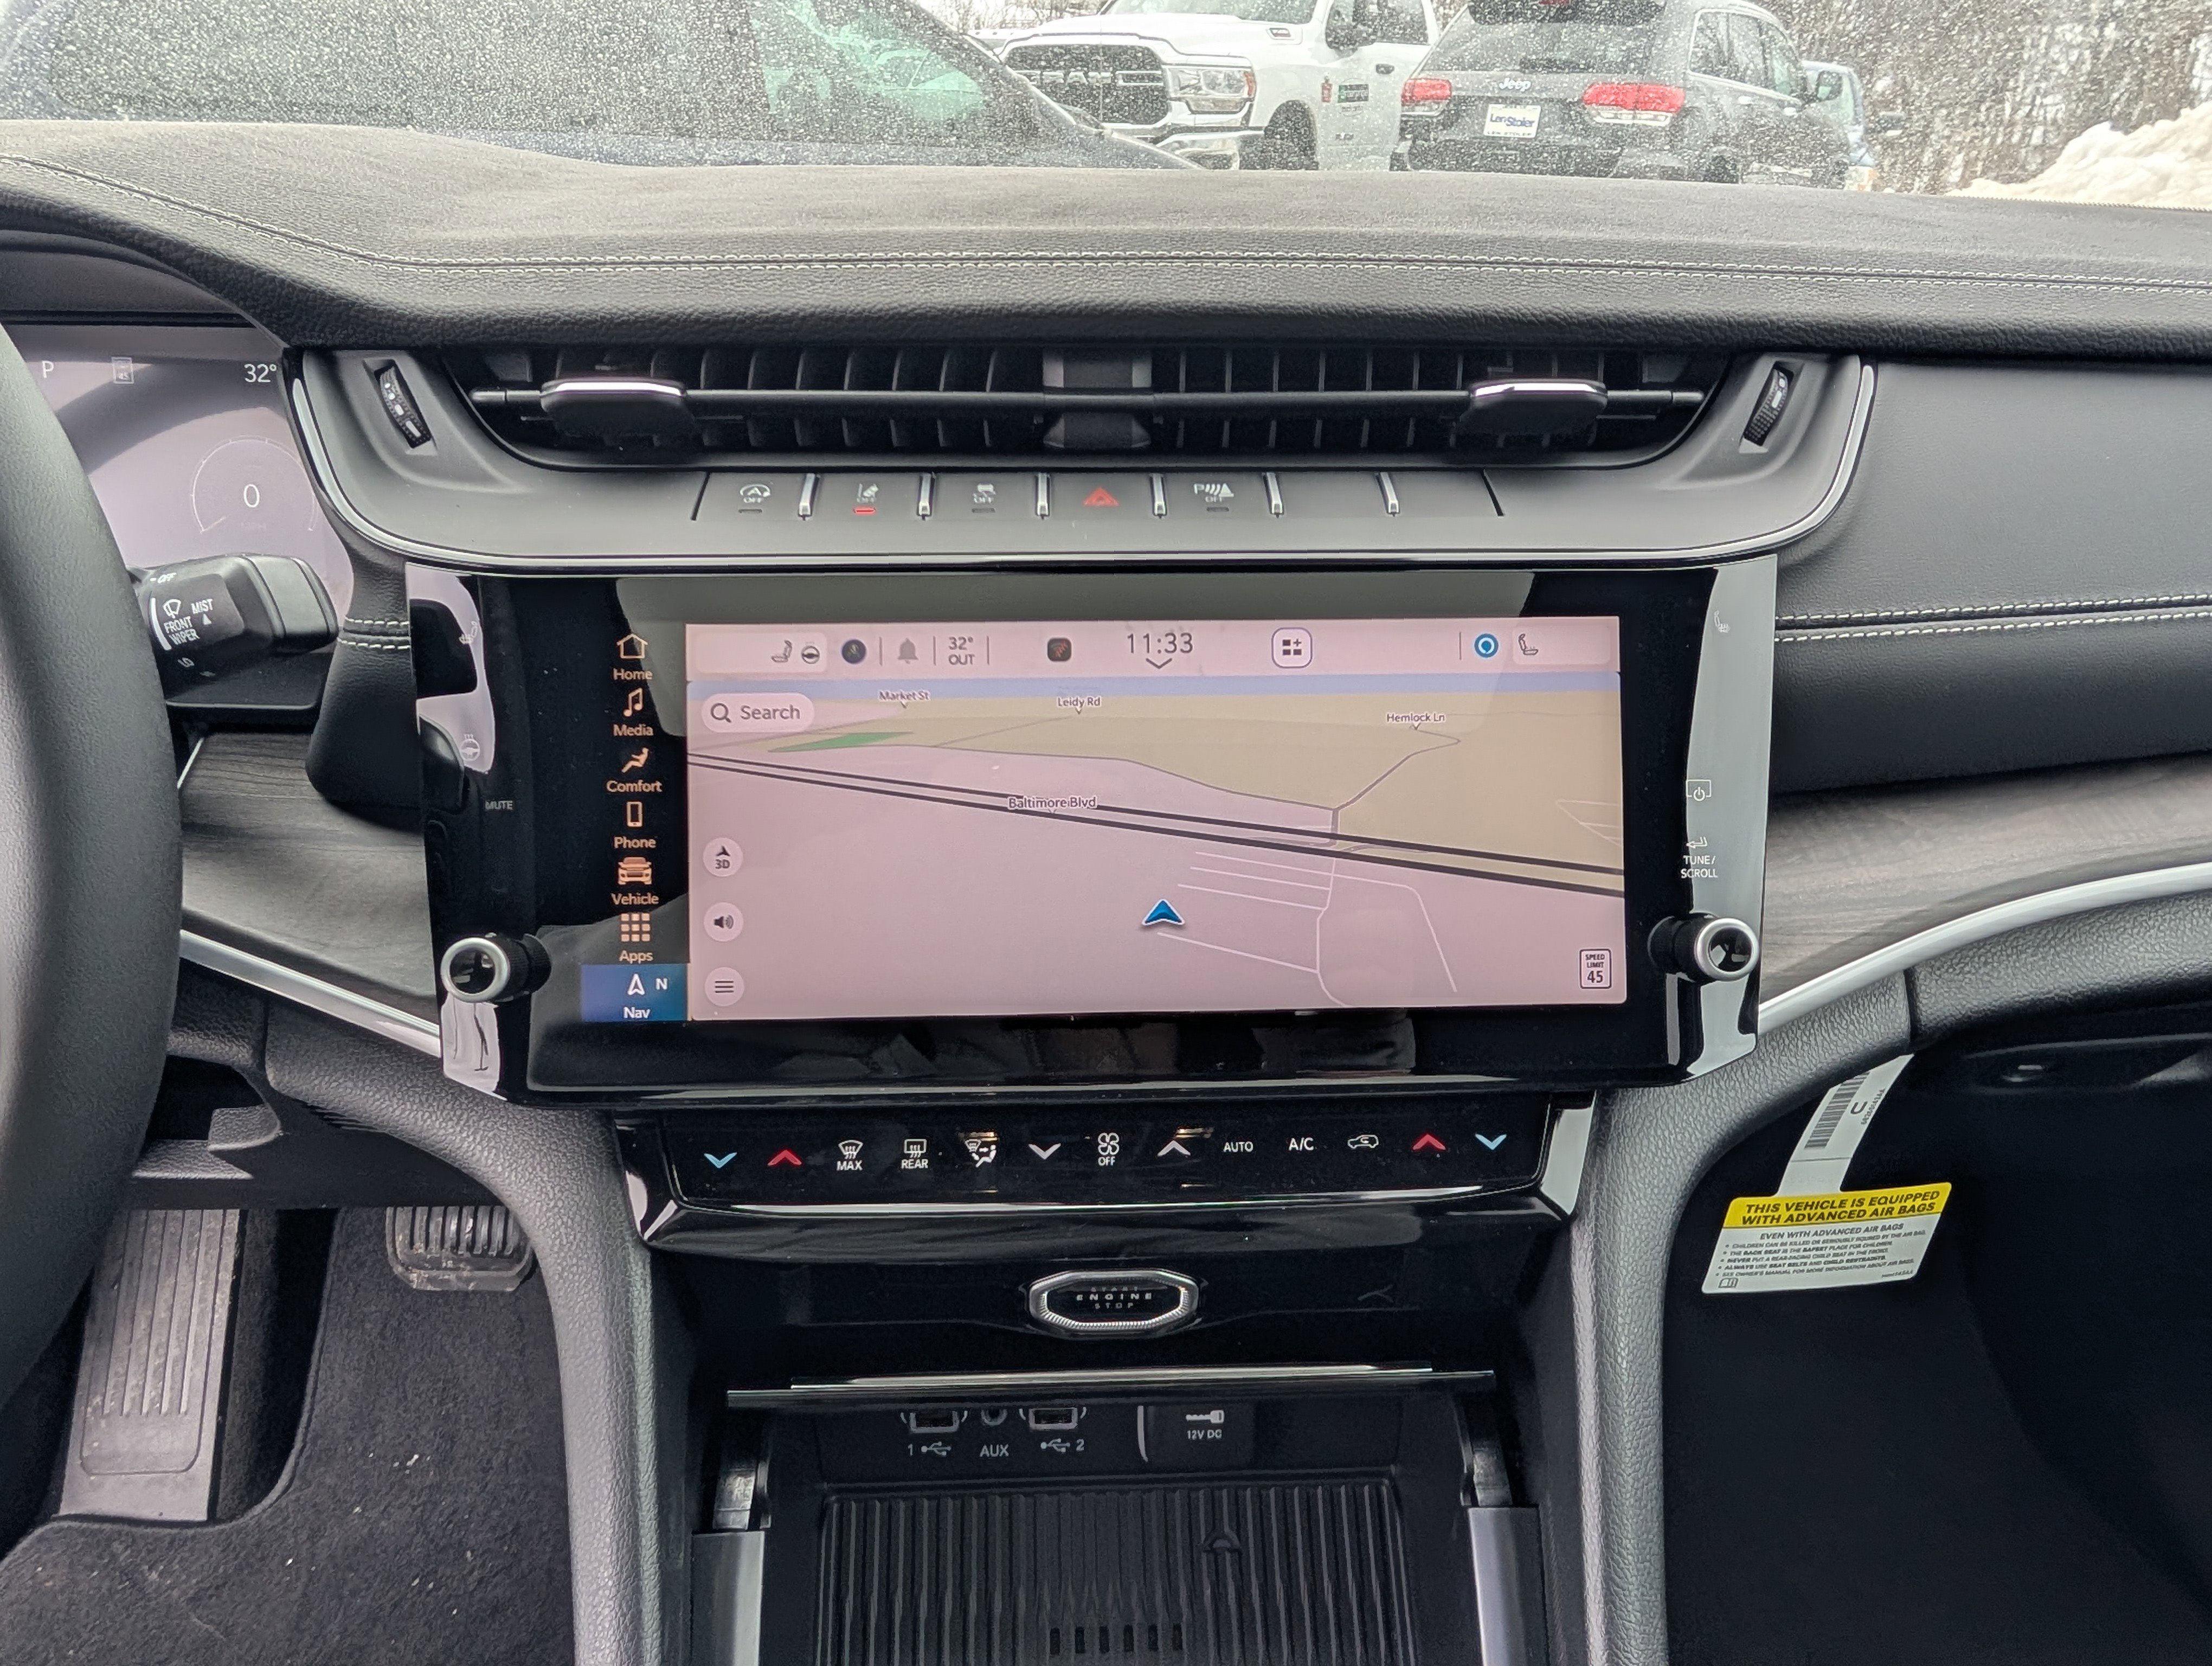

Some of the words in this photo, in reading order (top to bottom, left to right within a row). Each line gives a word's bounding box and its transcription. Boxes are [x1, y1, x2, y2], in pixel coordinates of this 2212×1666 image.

[1499, 78, 1531, 92] Jeep
[42, 361, 55, 378] P
[244, 363, 277, 382] 32°
[191, 599, 213, 615] MIST
[164, 616, 193, 633] FRONT
[169, 629, 200, 645] WIPER
[948, 636, 974, 650] 32°
[1127, 632, 1193, 655] 11:33
[948, 654, 975, 665] OUT
[613, 668, 653, 680] Home
[879, 691, 915, 701] Market
[917, 690, 929, 700] St
[1058, 697, 1084, 708] Leidy
[1087, 697, 1101, 706] Rd
[740, 704, 801, 720] Search
[1386, 713, 1431, 722] Hemlock
[1433, 713, 1445, 722] Ln
[613, 725, 653, 736] Media
[606, 780, 663, 792] Comfort
[485, 800, 513, 810] MUTE
[1009, 797, 1067, 808] Baltimore
[1070, 796, 1096, 808] Blvd
[614, 836, 657, 849] Phone
[715, 859, 731, 869] 3D
[1683, 855, 1716, 866] TUNE/
[1681, 868, 1718, 879] SCROLL
[612, 893, 659, 906] Vehicle
[619, 950, 654, 964] Apps
[1587, 970, 1604, 983] 45
[655, 978, 668, 990] N
[623, 1007, 651, 1019] Nav
[1224, 1142, 1254, 1152] AUTO
[1288, 1137, 1314, 1151] A/C
[837, 1160, 863, 1171] MAX
[901, 1159, 929, 1169] REAR
[1098, 1157, 1116, 1167] OFF
[1746, 1203, 1781, 1214] THIS
[1785, 1198, 1848, 1212] VEHICLE
[1850, 1197, 1866, 1208] IS
[1868, 1190, 1940, 1207] EQUIPPED
[1742, 1214, 1782, 1225] WITH
[1784, 1209, 1867, 1223] ADVANCED
[1869, 1206, 1895, 1218] AIR
[1898, 1202, 1936, 1215] BAGS
[1760, 1232, 1784, 1240] EVEN
[1787, 1231, 1810, 1239] WITH
[1812, 1227, 1861, 1237] ADVANCED
[1863, 1225, 1879, 1233] AIR
[1880, 1223, 1904, 1232] BAGS
[1076, 1292, 1152, 1301] ENGINE
[1187, 1429, 1205, 1440] 12V
[1207, 1428, 1223, 1439] DC
[907, 1443, 914, 1456] 1
[979, 1444, 1009, 1457] AUX
[1076, 1438, 1085, 1451] 2
